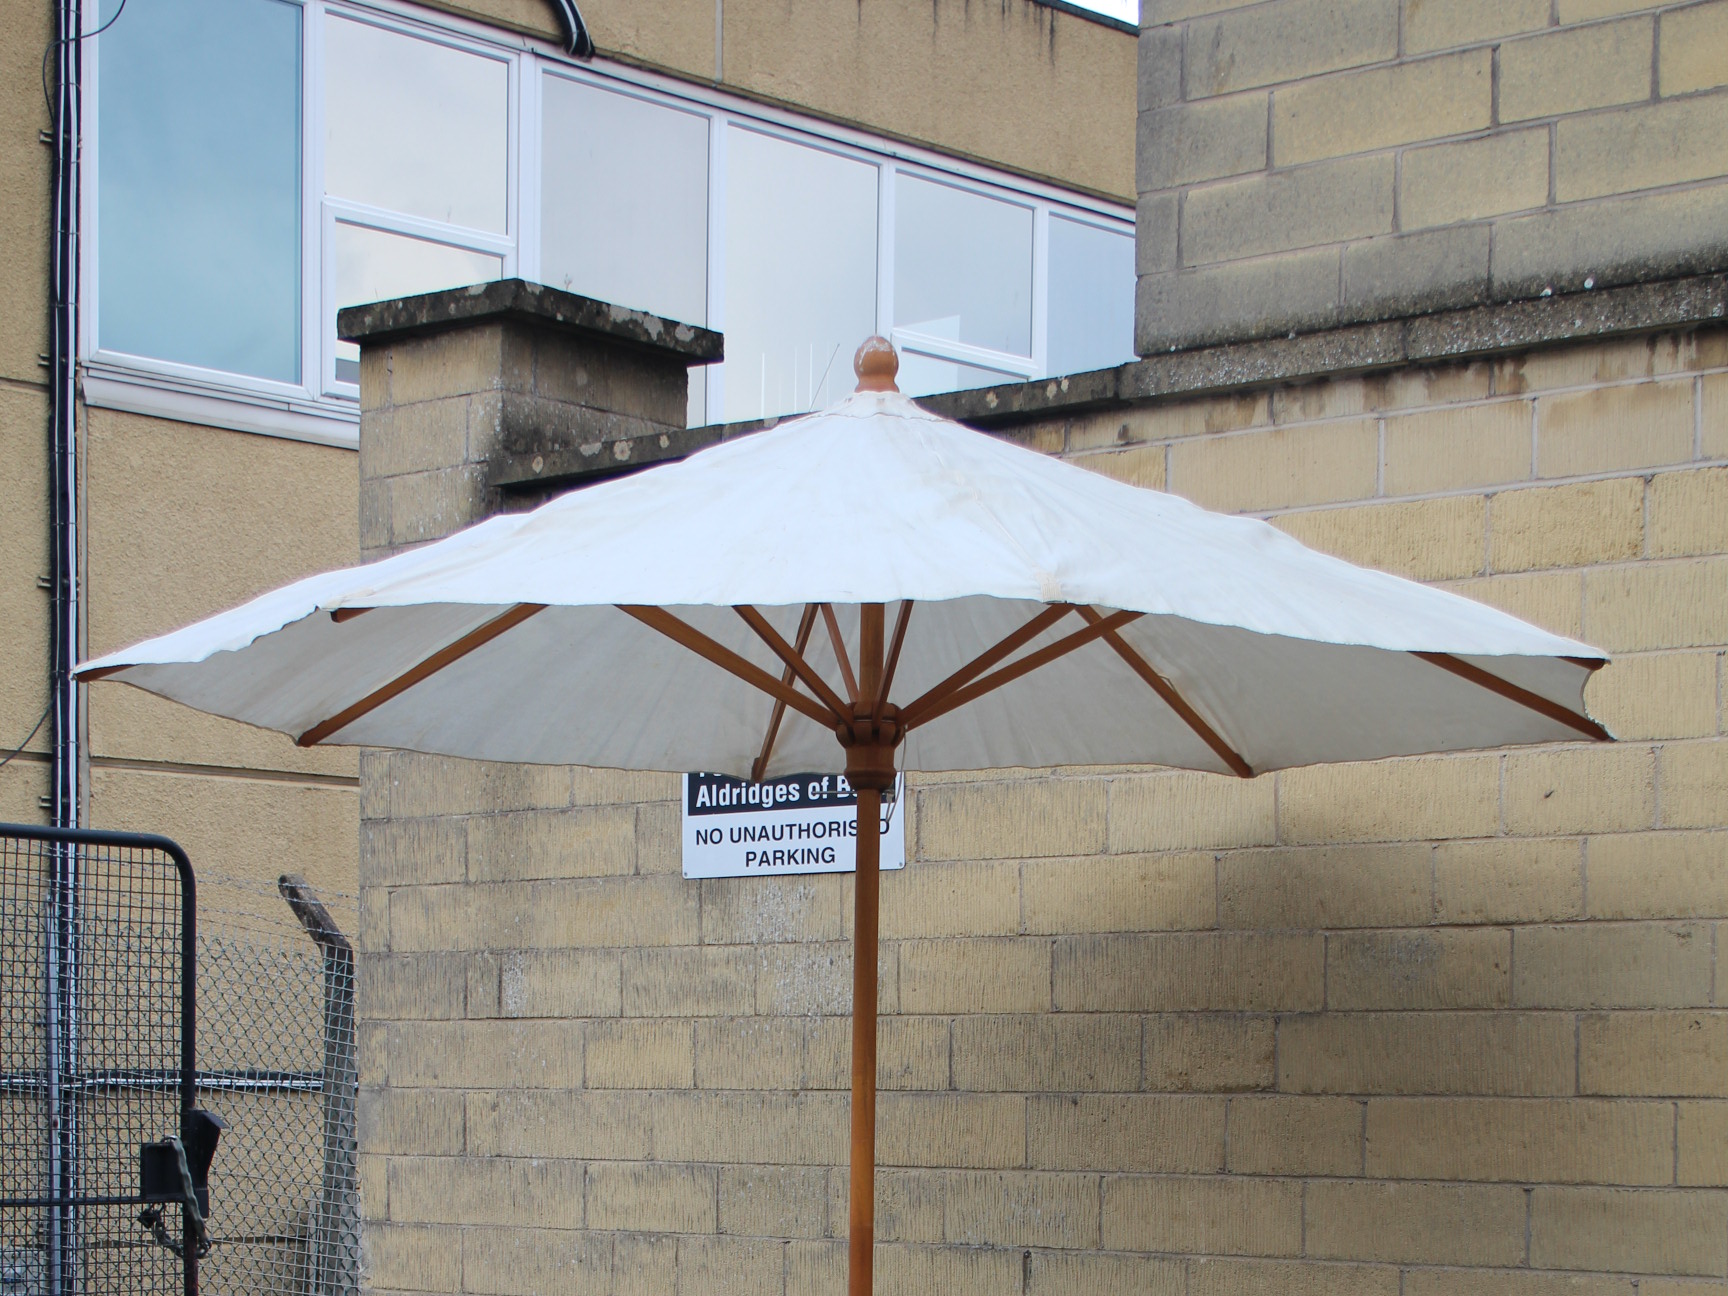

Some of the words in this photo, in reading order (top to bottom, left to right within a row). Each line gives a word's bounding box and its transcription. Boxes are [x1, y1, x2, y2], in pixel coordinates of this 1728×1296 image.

[695, 783, 800, 808] Aldridges
[807, 776, 829, 800] of
[696, 828, 723, 845] NO
[730, 819, 890, 843] UNAUTHORISD
[745, 847, 836, 867] PARKING
